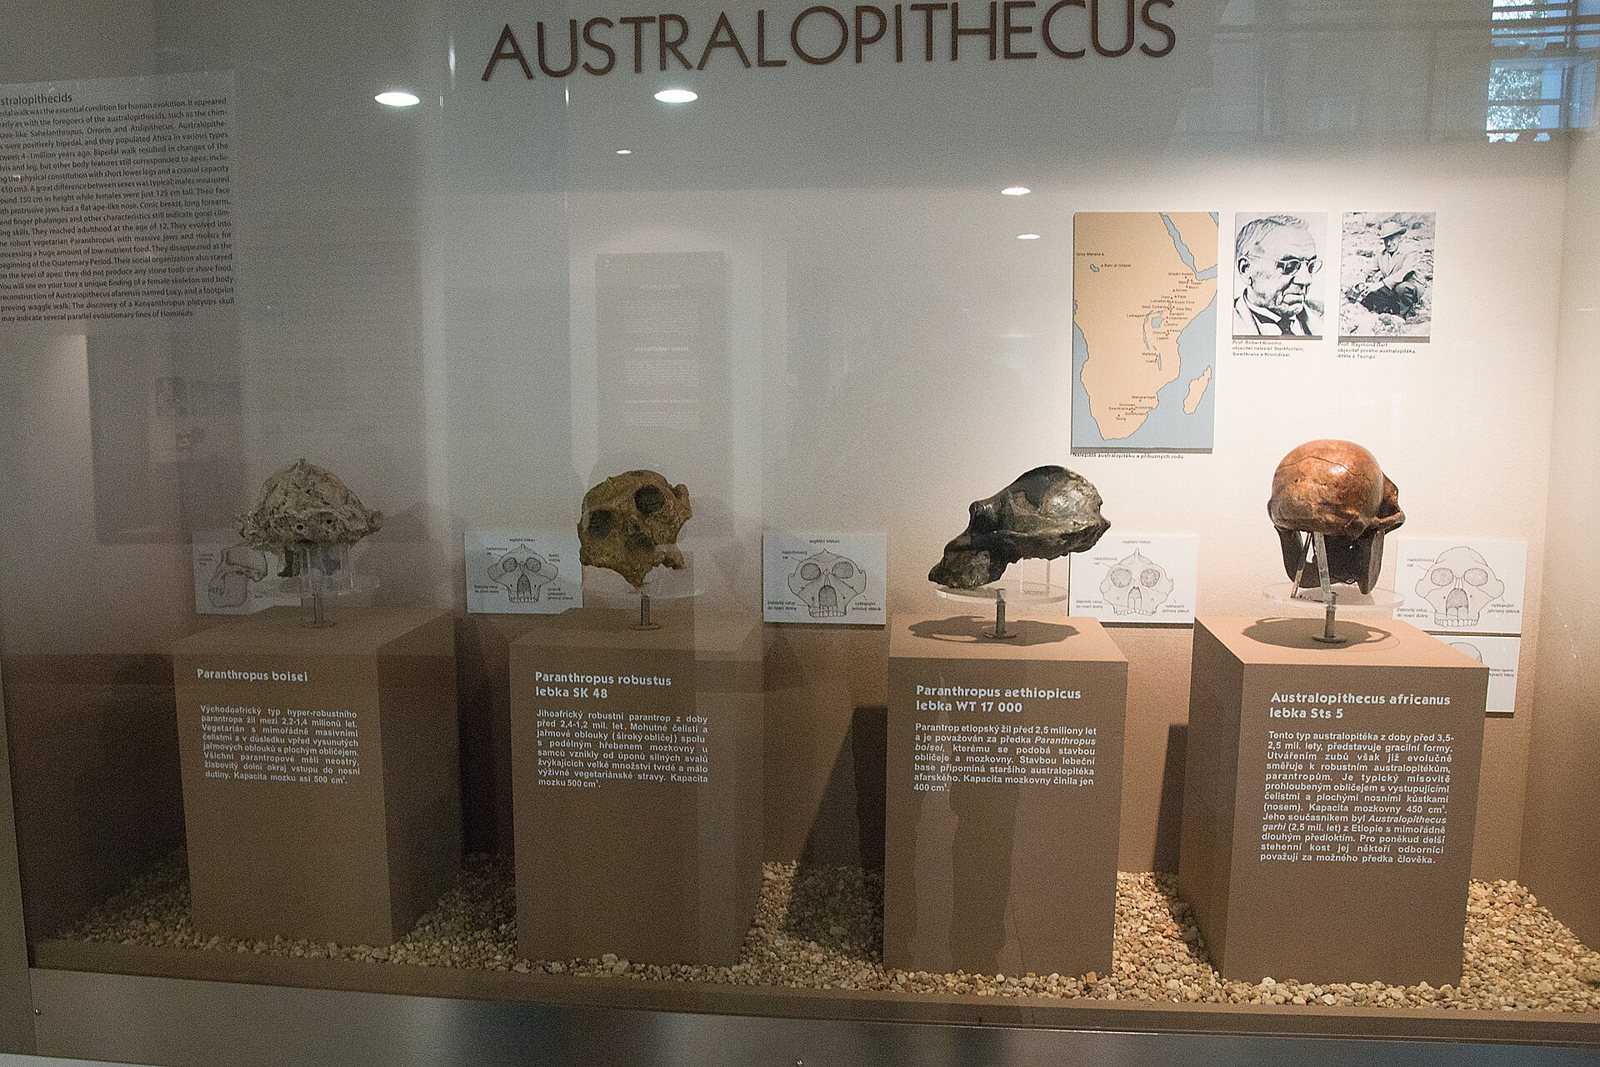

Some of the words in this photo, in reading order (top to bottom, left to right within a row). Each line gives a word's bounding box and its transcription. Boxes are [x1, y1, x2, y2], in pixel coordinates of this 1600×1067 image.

[482, 0, 1176, 81] AUSTRALOPITHECUS
[197, 669, 269, 682] Paranthropus
[272, 671, 308, 681] boisei
[535, 672, 614, 686] Paranthropus
[618, 675, 671, 686] robustus
[535, 686, 570, 697] lebka
[573, 688, 588, 698] SK
[593, 689, 608, 698] 48
[916, 686, 1001, 699] Paranthropus
[1005, 688, 1081, 701] aethiopicus
[1271, 693, 1386, 706] Australopithecus
[1389, 695, 1450, 705] africanus
[916, 701, 952, 711] lebka
[956, 701, 976, 711] WT
[981, 702, 994, 712] 17
[998, 702, 1022, 712] 000
[588, 711, 624, 720] robustní
[628, 712, 671, 723] parantrop
[686, 714, 708, 724] doby
[1269, 708, 1307, 718] lebka
[1310, 709, 1332, 718] Sts
[1336, 710, 1343, 718] 5
[915, 723, 960, 733] Parantrop
[961, 724, 1000, 734] etiopský
[1001, 725, 1012, 733] žil
[1013, 725, 1034, 735] před
[1035, 726, 1049, 735] 2,5
[1050, 726, 1084, 736] miliony
[1085, 727, 1097, 735] let
[1270, 731, 1294, 739] Tento
[1296, 732, 1311, 741] typ
[1388, 733, 1412, 742] doby
[1413, 734, 1435, 743] před
[537, 748, 566, 756] samců
[569, 749, 599, 760] vznikly
[618, 751, 646, 762] úponů
[649, 753, 681, 763] silných
[684, 754, 708, 763] svalů
[952, 744, 990, 752] kterému
[1016, 746, 1051, 755] podobá
[1058, 747, 1096, 755] stavbou
[914, 753, 950, 763] obličeje
[1019, 756, 1057, 764] Stavbou
[1062, 756, 1095, 765] lebeční
[1267, 751, 1317, 760] Utvářením
[1325, 752, 1349, 760] zubů
[1357, 753, 1380, 761] však
[1387, 754, 1400, 763] již
[1407, 754, 1452, 762] evolučně
[1266, 762, 1303, 771] směřuje
[1309, 762, 1315, 770] k
[1320, 762, 1368, 771] robustním
[538, 777, 566, 786] mozku
[567, 779, 582, 787] 500
[963, 774, 1003, 784] Kapacita
[1005, 775, 1051, 785] mozkovny
[1053, 776, 1078, 784] činila
[1080, 777, 1094, 786] jen
[1265, 782, 1332, 792] prohloubeným
[1333, 783, 1378, 793] obličejem
[1262, 812, 1286, 820] Jeho
[1351, 814, 1366, 823] byl
[1261, 842, 1302, 850] stehenní
[1309, 843, 1330, 851] kost
[1337, 844, 1349, 853] jej
[1357, 844, 1390, 852] někteří
[1398, 845, 1444, 853] odborníci
[1260, 852, 1298, 862] považují
[1316, 853, 1358, 862] možného
[1362, 854, 1394, 864] předka
